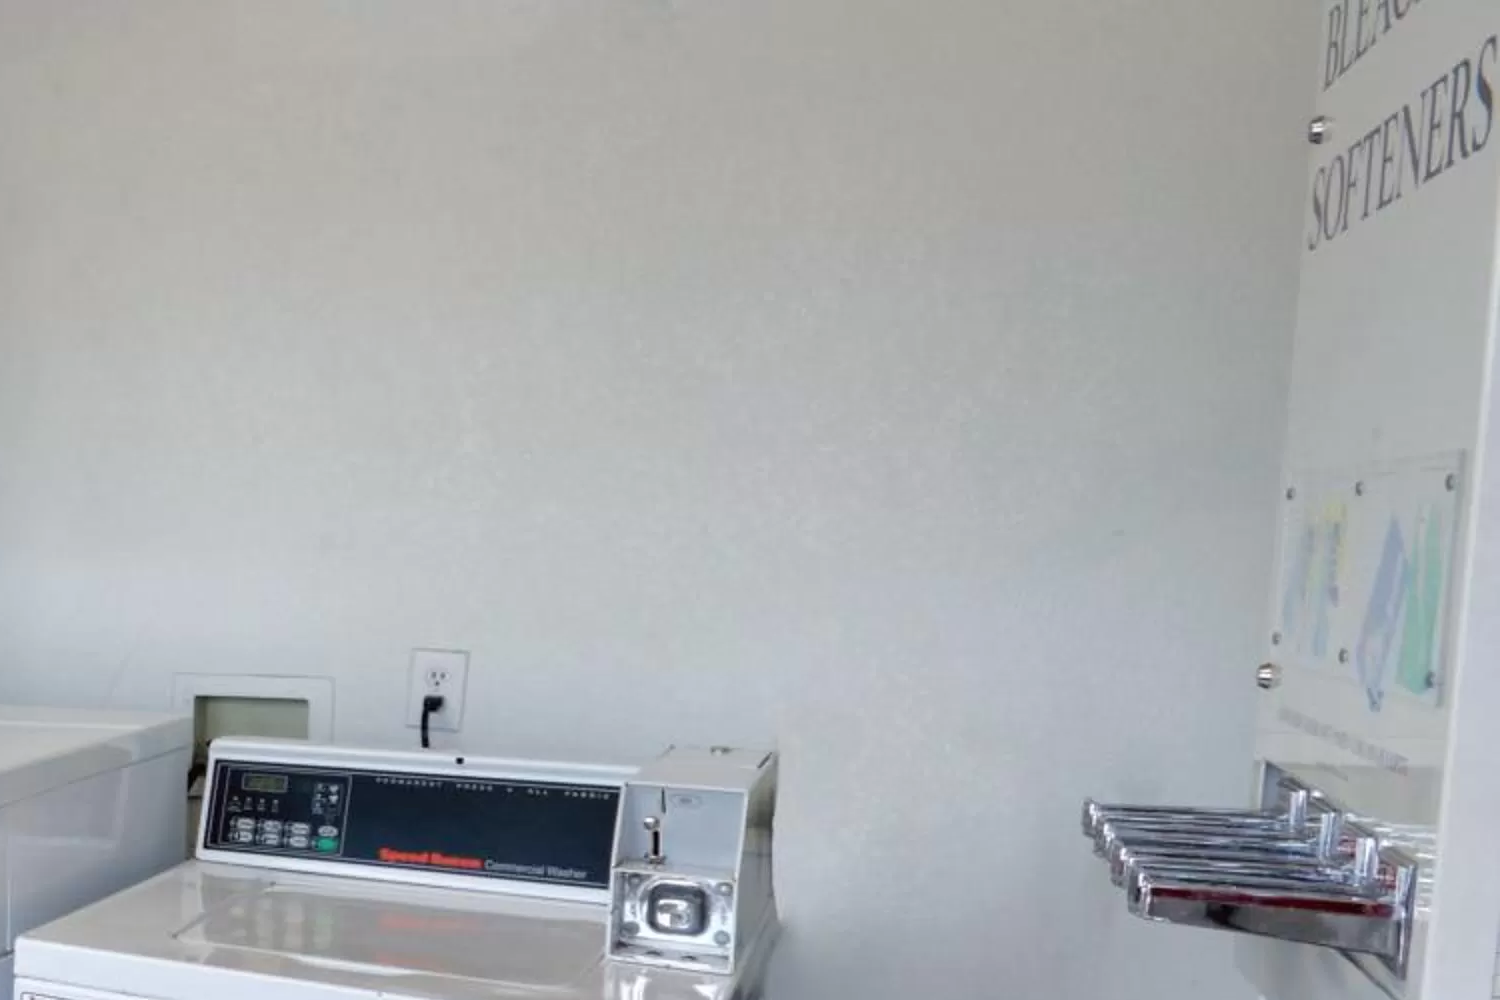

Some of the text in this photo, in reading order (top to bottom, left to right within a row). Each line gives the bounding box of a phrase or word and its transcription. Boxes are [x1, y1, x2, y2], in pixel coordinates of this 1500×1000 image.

[1307, 34, 1498, 252] SOFTENERS
[485, 859, 544, 876] Commercial
[547, 865, 588, 879] Washer
